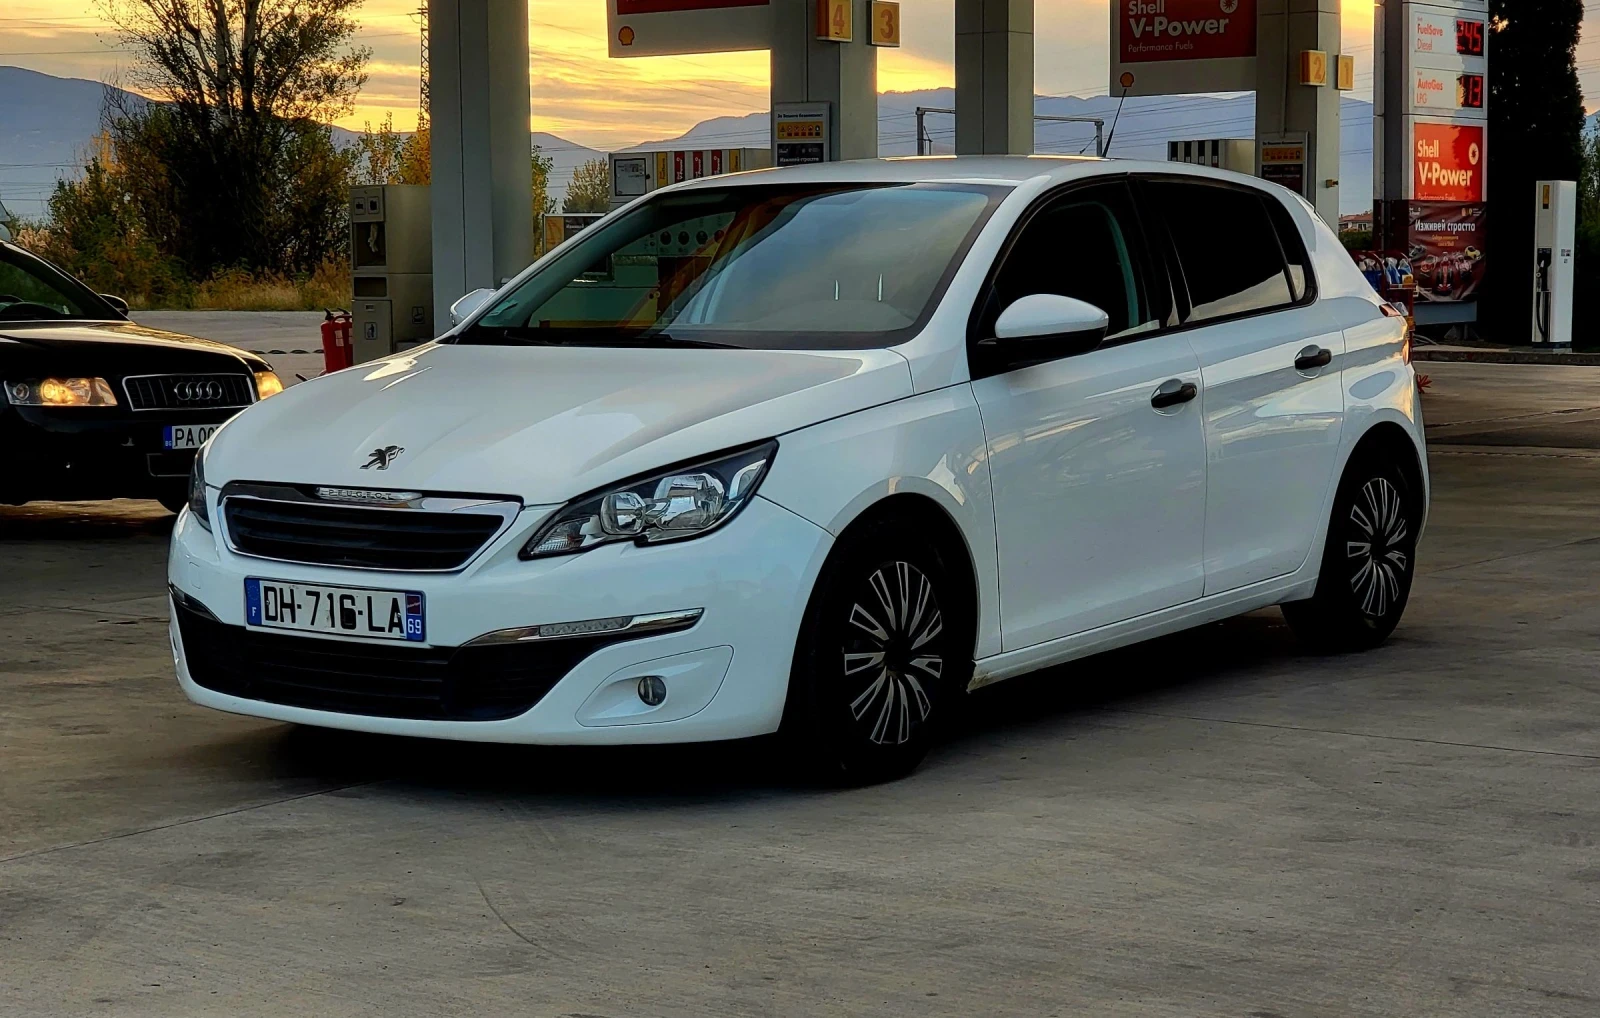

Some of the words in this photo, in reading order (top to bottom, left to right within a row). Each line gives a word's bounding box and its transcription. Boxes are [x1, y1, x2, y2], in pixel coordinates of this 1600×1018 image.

[832, 4, 845, 28] 4
[1128, 0, 1165, 15] Shell
[880, 9, 894, 39] 3
[1128, 16, 1229, 38] V-Power
[1417, 23, 1443, 37] FuelSave
[1128, 43, 1173, 53] Performance
[1175, 41, 1194, 51] Fuels
[1417, 38, 1433, 51] Diesel
[1313, 57, 1323, 79] 2
[1343, 63, 1350, 83] 1
[1417, 78, 1443, 91] AutoGas
[1416, 92, 1428, 104] LPG
[1417, 139, 1439, 158] Shell
[1418, 161, 1473, 187] V-Power
[1414, 218, 1446, 232] Изживей
[1447, 222, 1476, 235] страстта
[174, 427, 195, 447] PA
[198, 425, 220, 444] 00
[328, 489, 392, 500] PEUGEOT
[251, 606, 257, 617] F
[263, 585, 404, 634] DH-716-LA
[407, 618, 422, 634] 69
